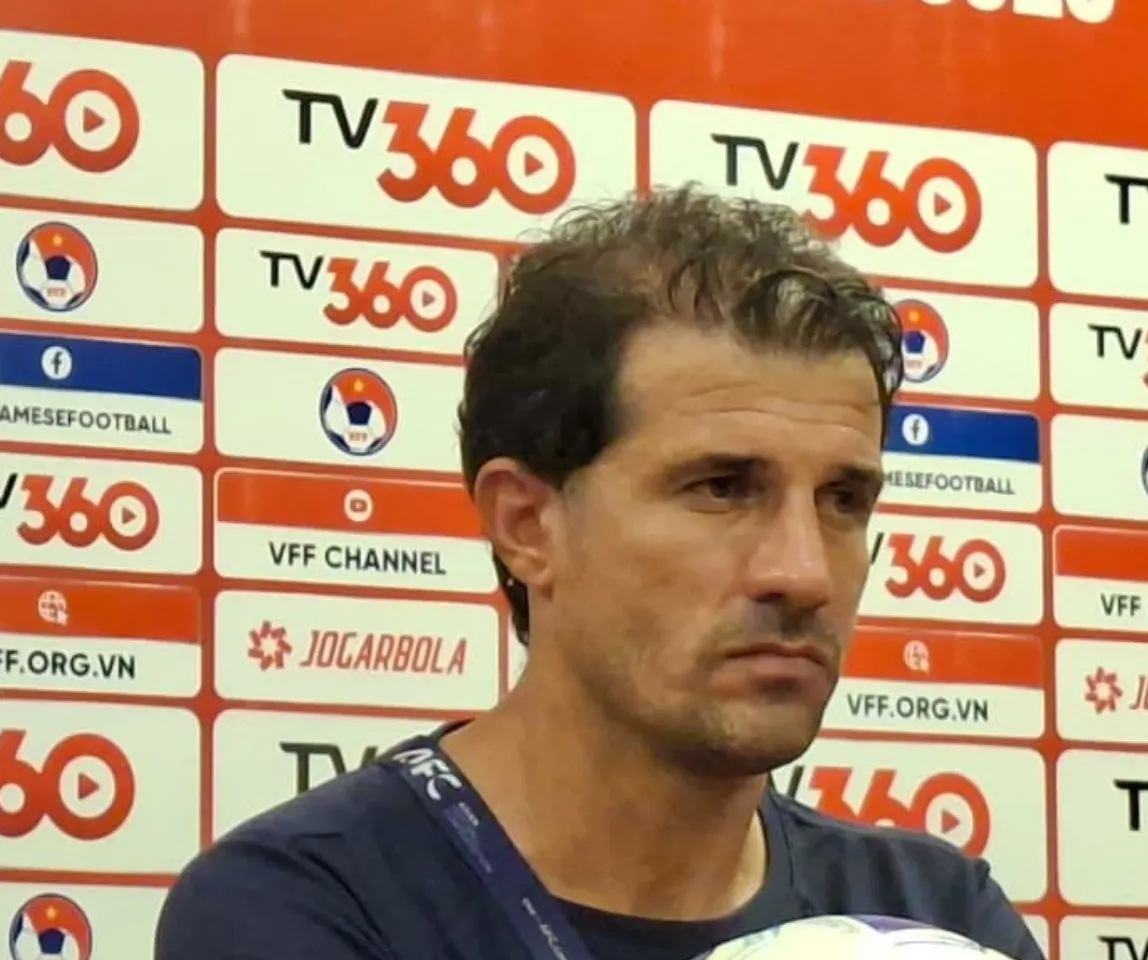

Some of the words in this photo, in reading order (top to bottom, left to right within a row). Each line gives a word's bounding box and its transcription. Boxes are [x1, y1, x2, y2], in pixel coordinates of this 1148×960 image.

[282, 88, 577, 214] TV360
[259, 249, 457, 333] TV360
[269, 541, 317, 567] VFF
[324, 545, 447, 576] CHANNEL
[1100, 592, 1142, 618] VFF
[299, 629, 468, 676] JOGARBOLA
[846, 692, 989, 723] VFF.ORG.VN
[392, 748, 463, 801] AFC
